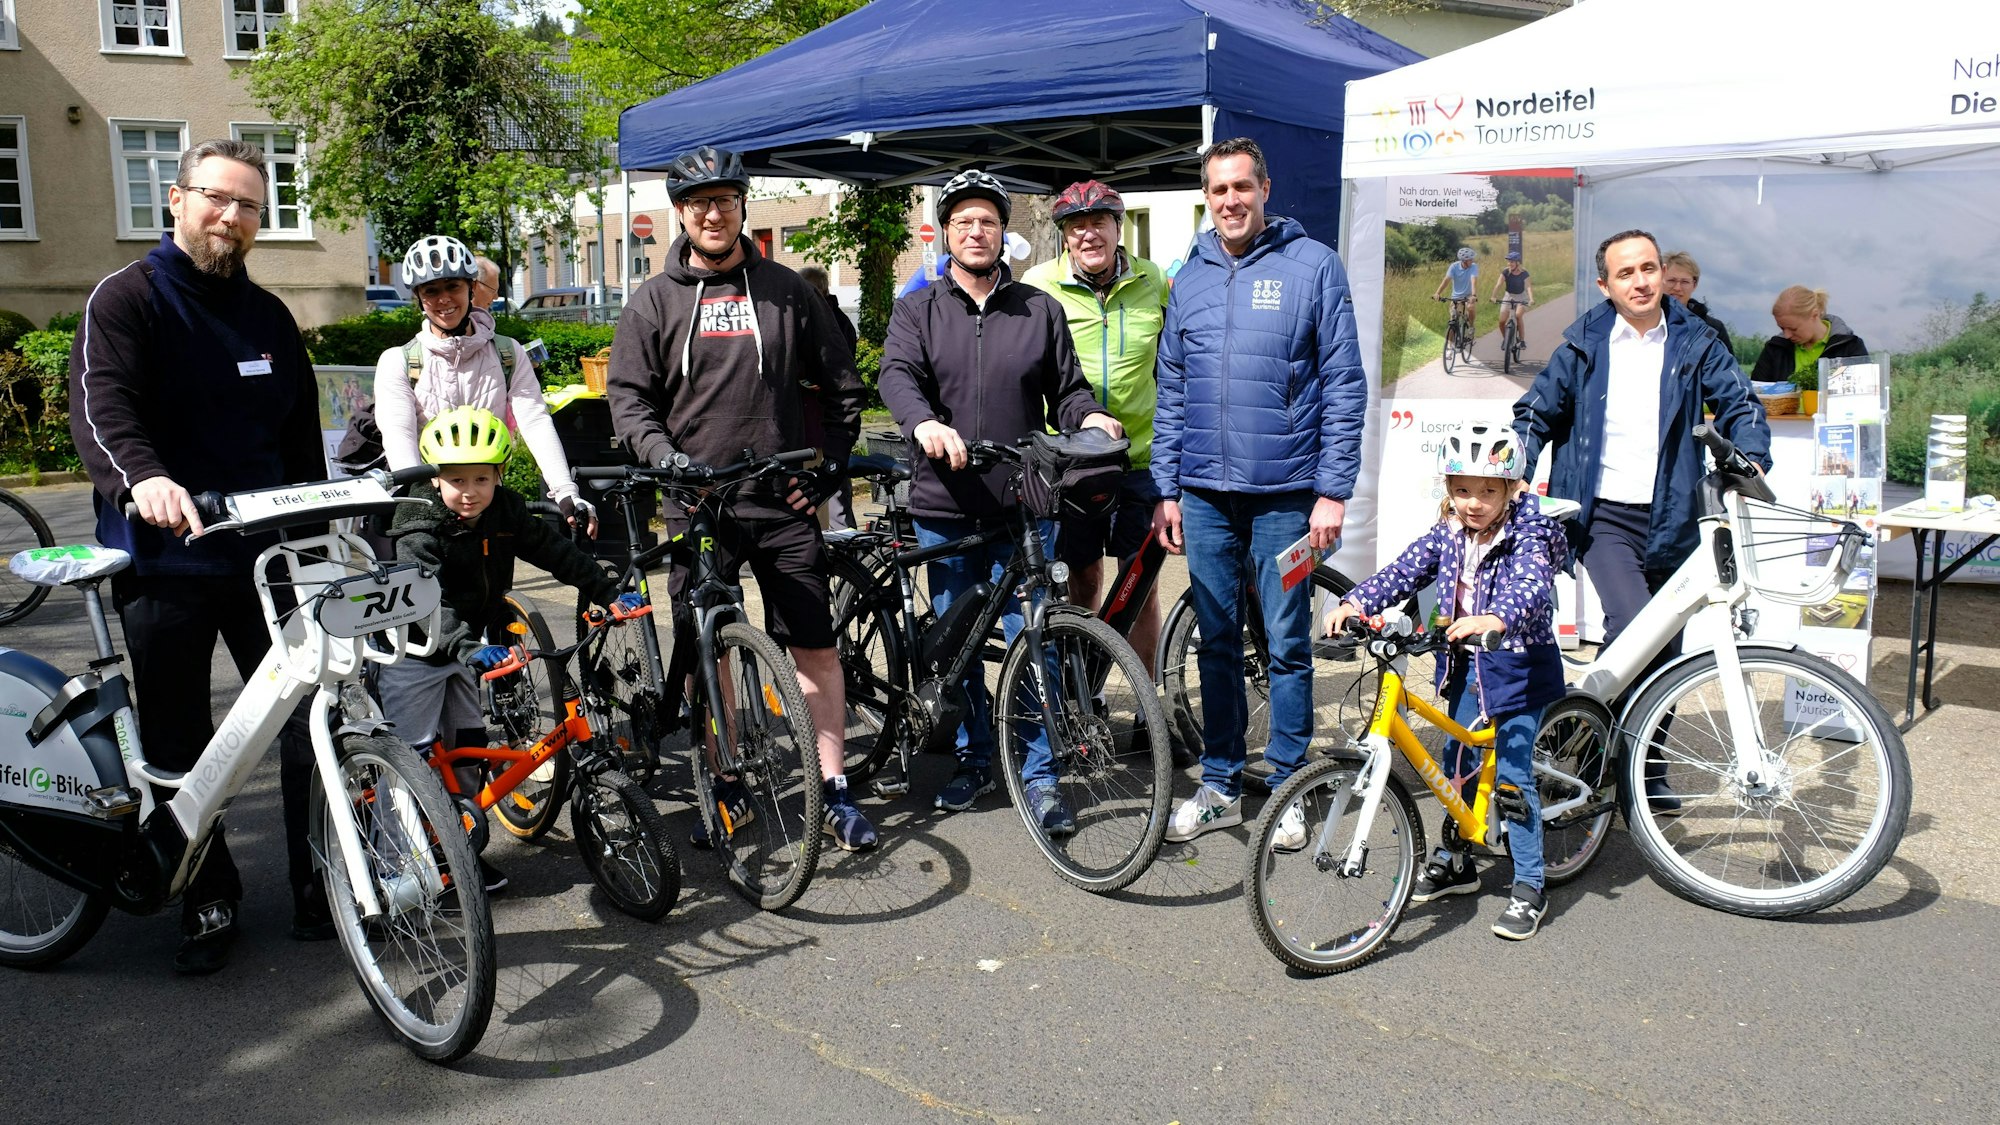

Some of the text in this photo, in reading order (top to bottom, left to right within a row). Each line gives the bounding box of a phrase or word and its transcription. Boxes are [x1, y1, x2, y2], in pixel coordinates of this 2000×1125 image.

[1476, 87, 1595, 119] Nordeifel
[1951, 91, 1997, 115] Die
[1474, 121, 1595, 144] Tourismus
[1399, 186, 1417, 195] Nah
[1419, 187, 1441, 196] dran.
[1443, 188, 1462, 196] Weit
[1399, 198, 1458, 208] Die Nordeifel
[700, 301, 751, 318] BRGR
[700, 316, 753, 332] MSTR
[1421, 420, 1463, 433] Losra
[700, 536, 714, 553] R
[1119, 572, 1138, 602] VICTORIA
[114, 716, 133, 760] 530614
[193, 706, 262, 799] nextbike
[0, 764, 29, 788] ifel
